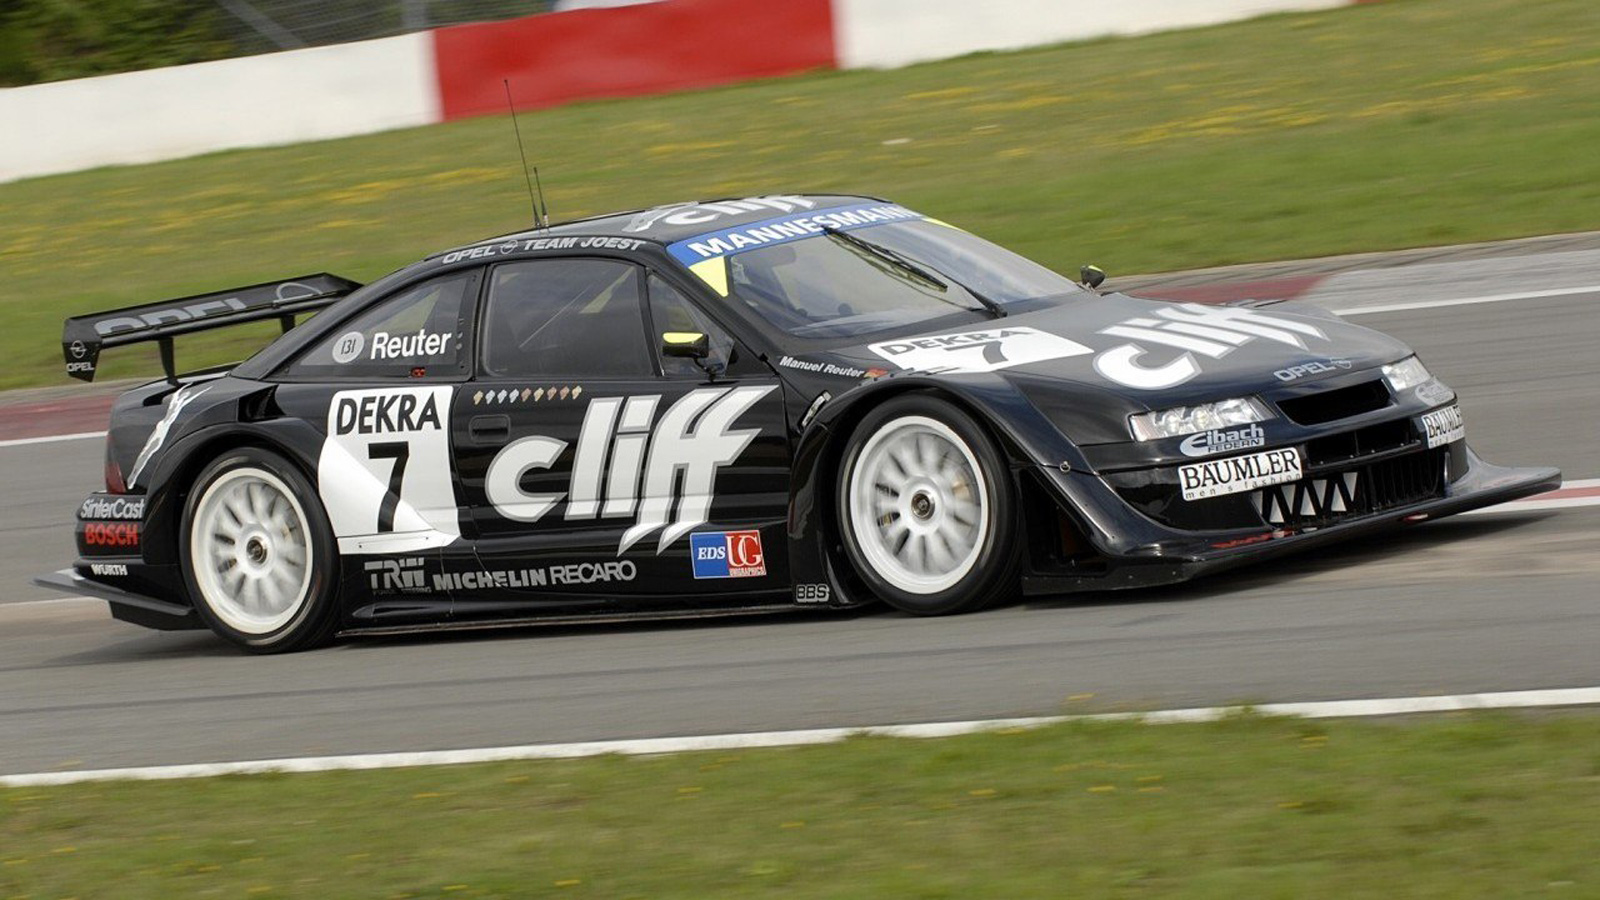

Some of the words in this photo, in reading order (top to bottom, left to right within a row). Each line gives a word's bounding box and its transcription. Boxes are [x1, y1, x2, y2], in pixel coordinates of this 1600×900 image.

[442, 245, 496, 265] OPEL
[523, 237, 577, 251] TEAM
[580, 236, 647, 251] JOEST
[370, 328, 453, 360] Reuter
[880, 330, 1035, 356] DEKRA
[943, 340, 1009, 365] 7
[1092, 302, 1331, 391] cliff
[66, 362, 95, 373] OPEL
[779, 355, 825, 372] Manuel
[823, 363, 865, 378] Reuter
[1273, 360, 1337, 383] OPEL
[336, 390, 442, 435] DEKRA
[1179, 423, 1264, 457] Eibach
[1208, 439, 1261, 453] FEDERN
[485, 384, 779, 558] cliff
[1181, 449, 1299, 490] BÄUMLER
[1244, 473, 1301, 489] fashion
[368, 441, 410, 533] 7
[80, 498, 145, 519] SinterCast
[85, 522, 138, 545] BOSCH
[697, 545, 726, 560] EDS
[364, 557, 425, 590] TRW
[432, 568, 548, 591] MICHELIN
[550, 560, 637, 585] RECARO
[796, 583, 830, 603] BBS
